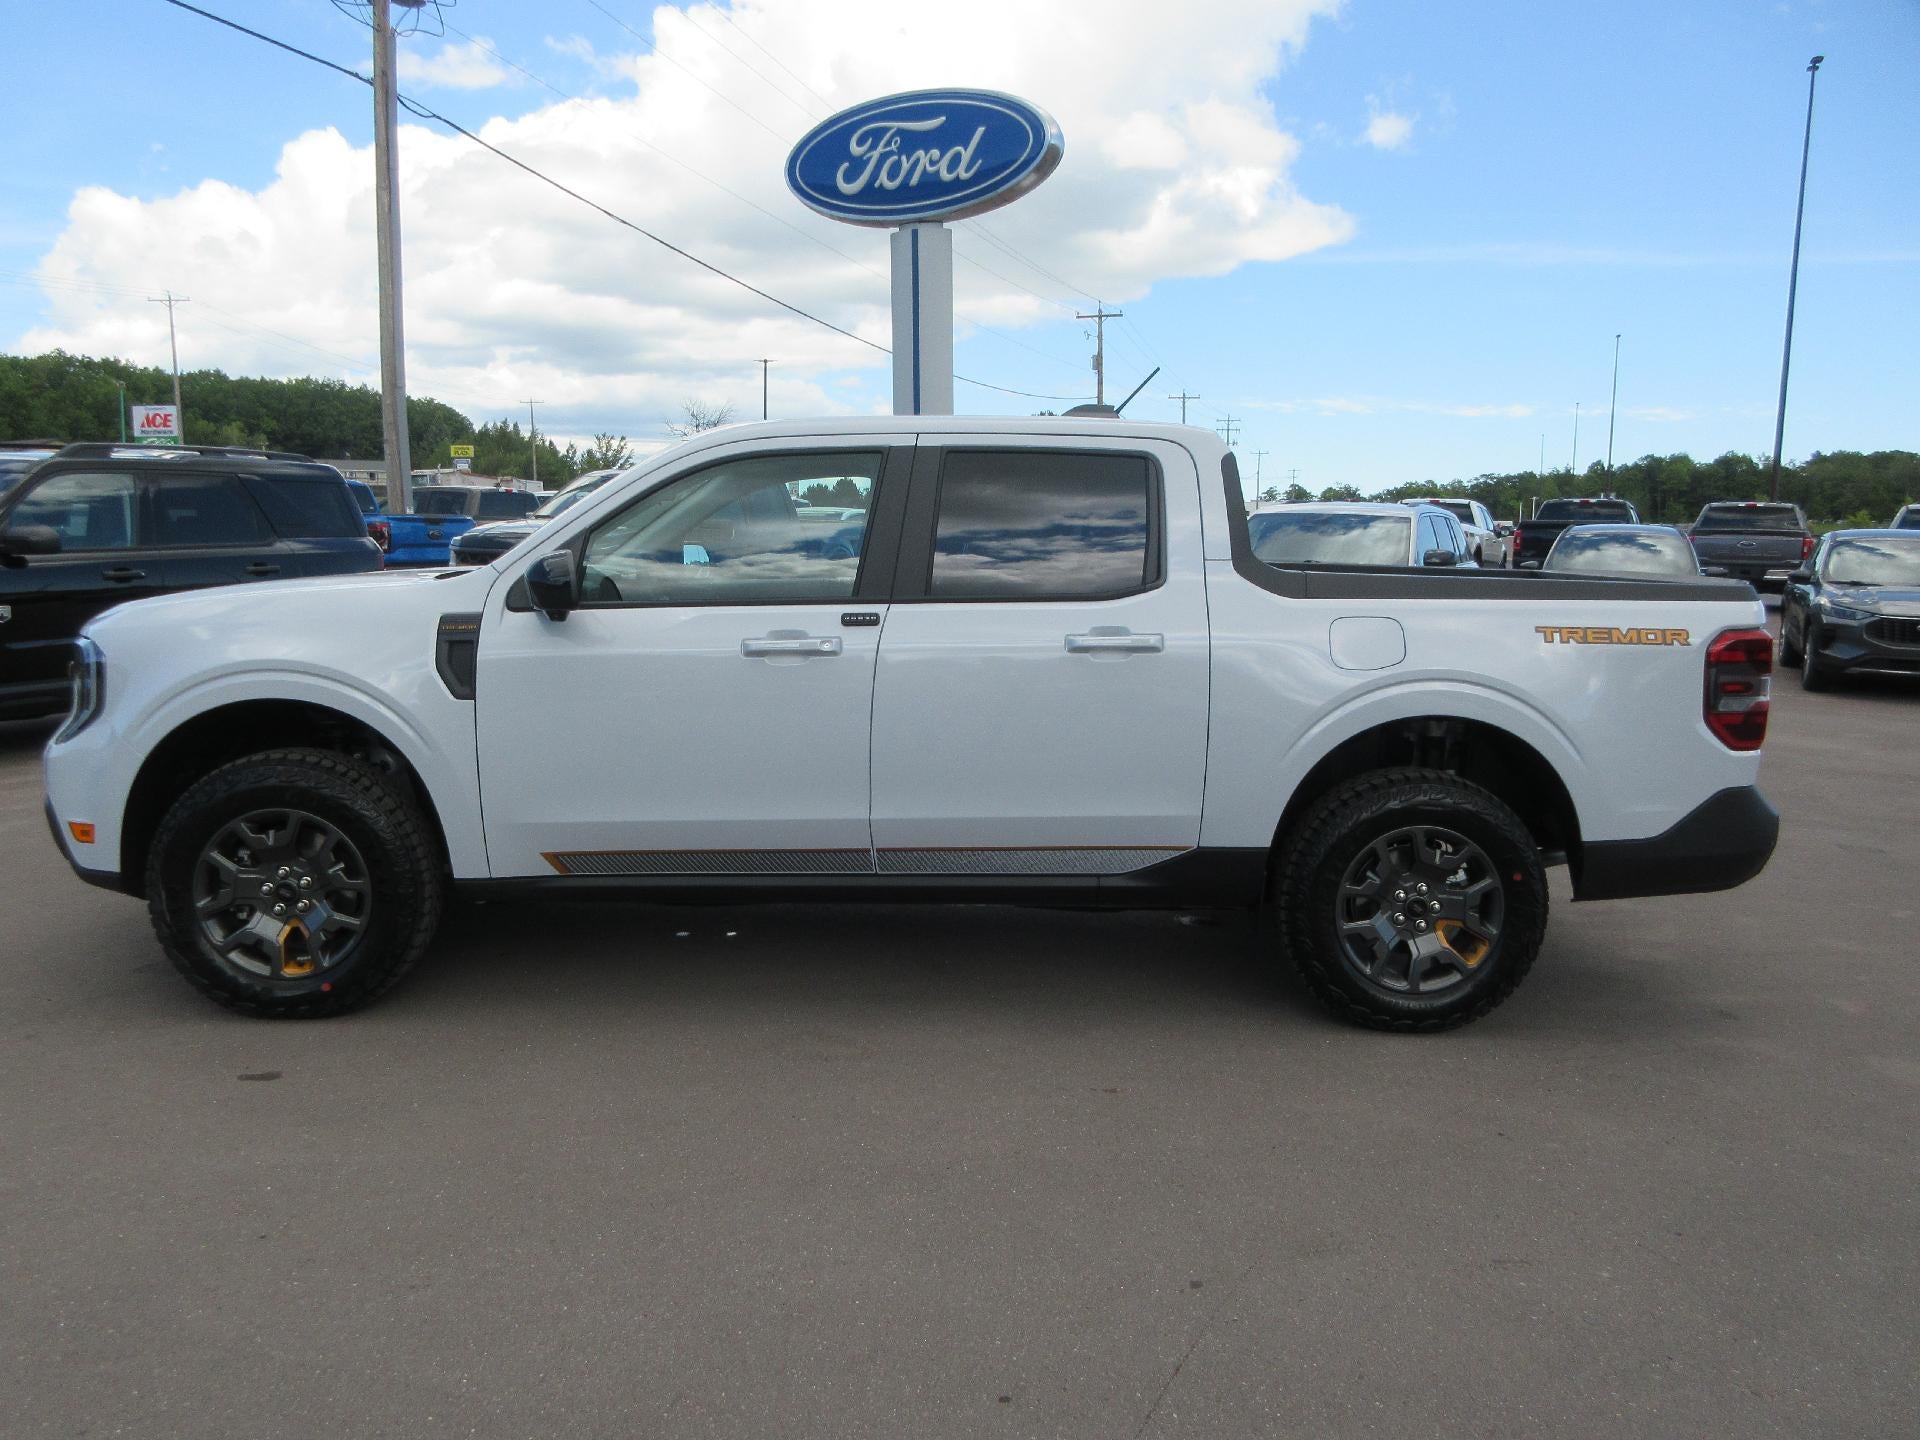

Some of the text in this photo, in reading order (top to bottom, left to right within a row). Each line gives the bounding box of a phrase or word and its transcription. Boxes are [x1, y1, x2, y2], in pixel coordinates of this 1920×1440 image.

[836, 116, 986, 195] Ford
[140, 412, 173, 428] ACE
[1535, 626, 1692, 647] TREMOR
